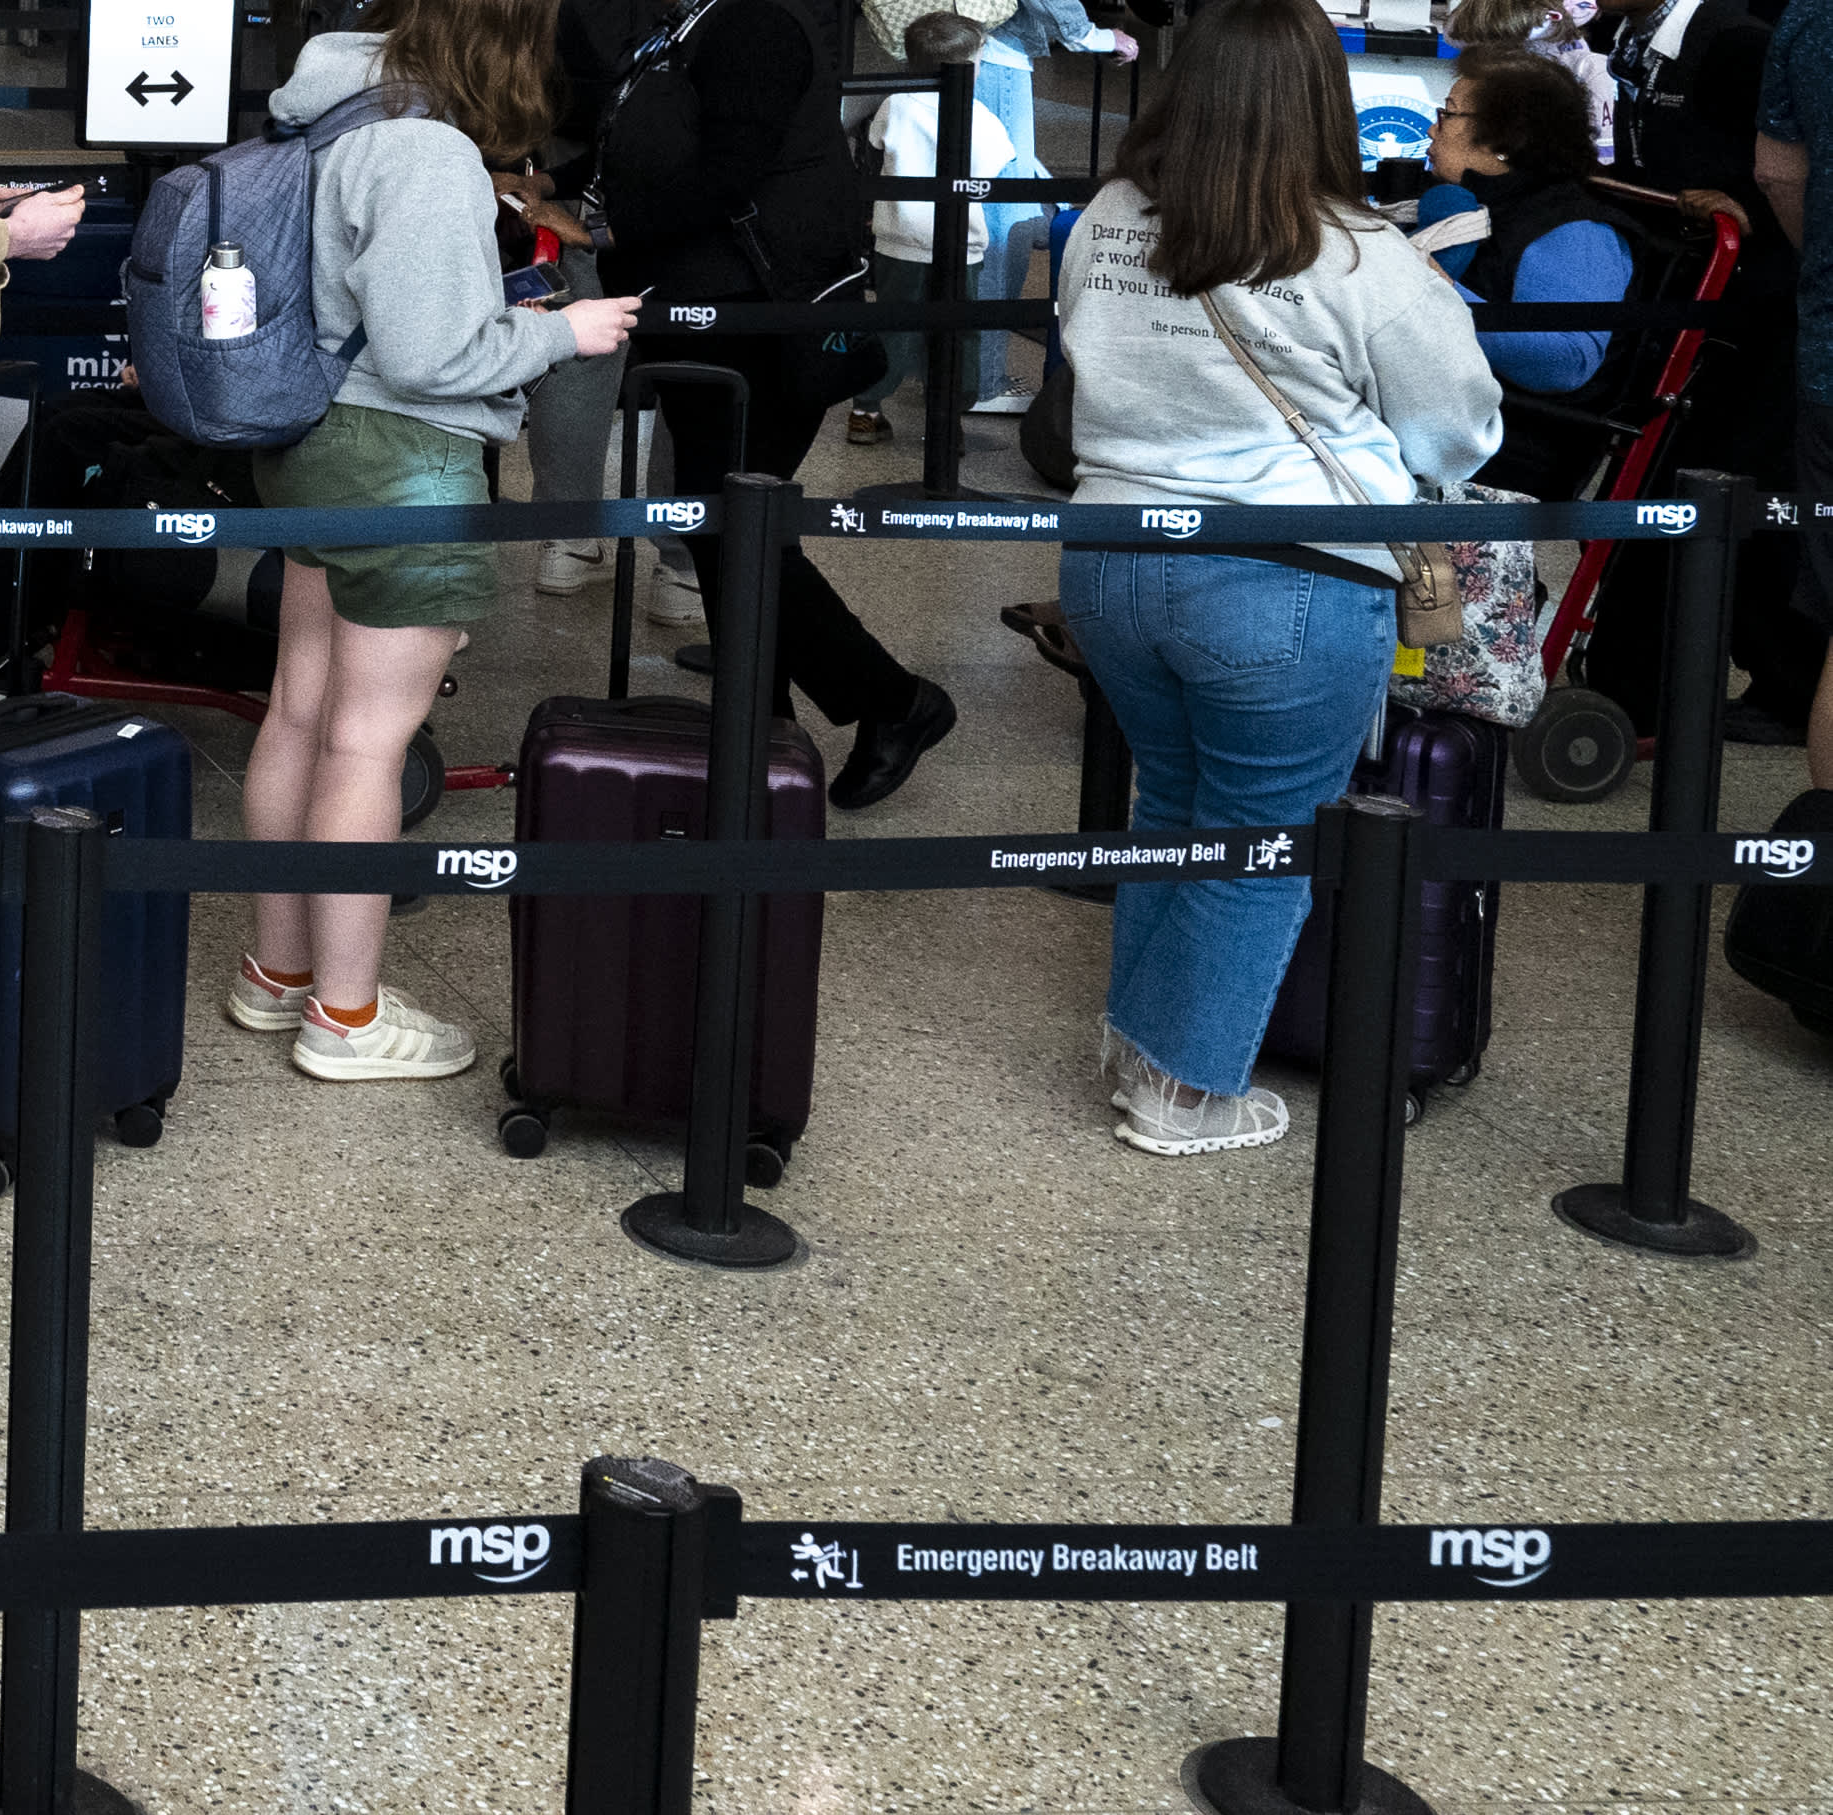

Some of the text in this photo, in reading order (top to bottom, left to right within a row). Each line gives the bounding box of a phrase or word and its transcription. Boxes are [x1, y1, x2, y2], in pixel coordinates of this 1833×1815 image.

[146, 15, 175, 26] TWO
[141, 35, 179, 47] LANES
[953, 179, 991, 196] msp
[1091, 223, 1163, 245] Dear pers
[1108, 251, 1148, 268] worl
[1117, 278, 1148, 296] you
[1249, 282, 1305, 307] place
[670, 305, 717, 324] msp
[1151, 320, 1210, 340] the person
[67, 351, 128, 377] mix
[155, 512, 215, 538] msp
[646, 501, 706, 526] msp
[881, 510, 1059, 532] Emergency Breakaway Belt
[1141, 508, 1202, 533] msp
[1636, 504, 1698, 529] msp
[46, 519, 73, 535] Belt
[436, 849, 519, 881] msp
[990, 842, 1227, 871] Emergency Breakaway Belt
[1733, 838, 1816, 871] msp
[429, 1523, 552, 1571] msp
[1429, 1528, 1552, 1576] msp
[897, 1542, 1259, 1578] Emergency Breakaway Belt
